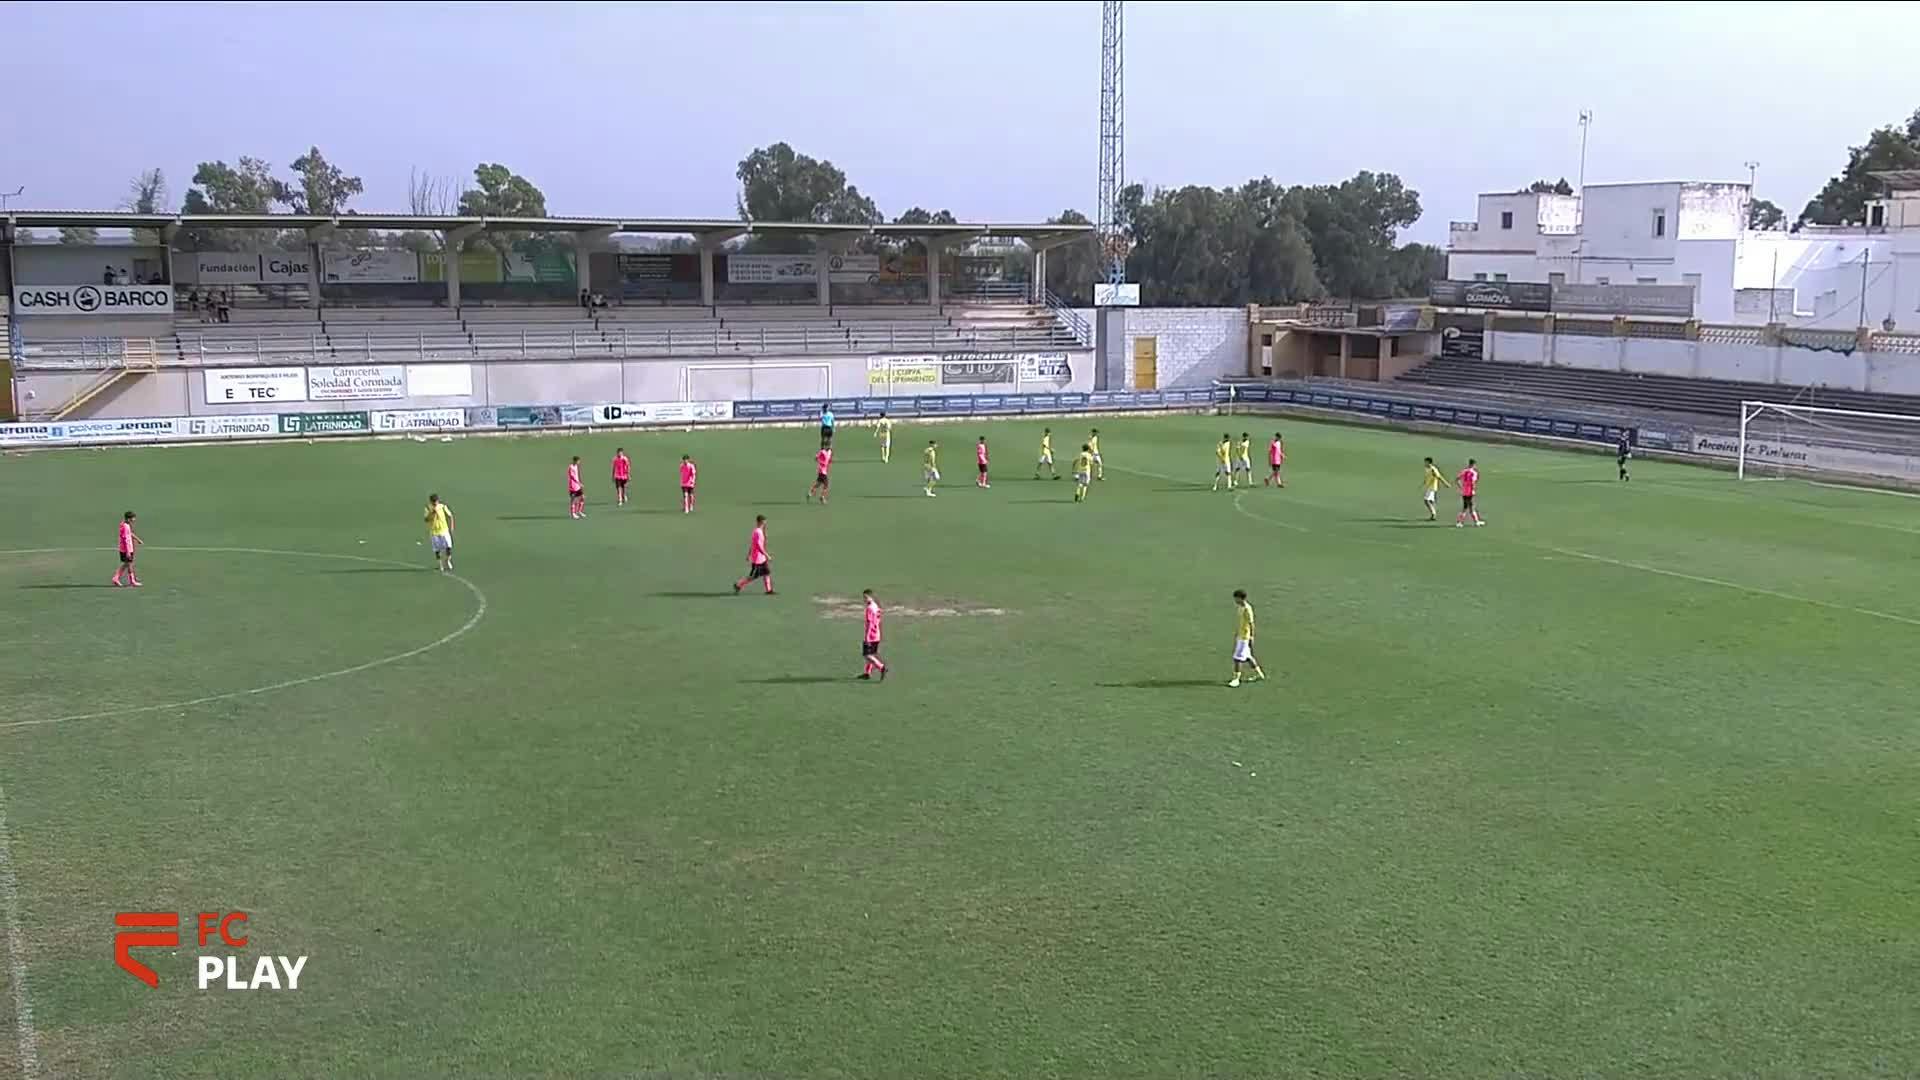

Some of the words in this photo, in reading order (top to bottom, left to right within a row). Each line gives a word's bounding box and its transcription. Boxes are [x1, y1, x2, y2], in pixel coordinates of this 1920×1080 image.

[269, 260, 309, 276] Cajas
[19, 291, 70, 307] CASH
[104, 290, 168, 306] BARCO
[311, 377, 351, 389] Soledad
[353, 376, 402, 387] Coronada
[0, 426, 48, 435] eroma
[116, 421, 172, 431] Jeroma
